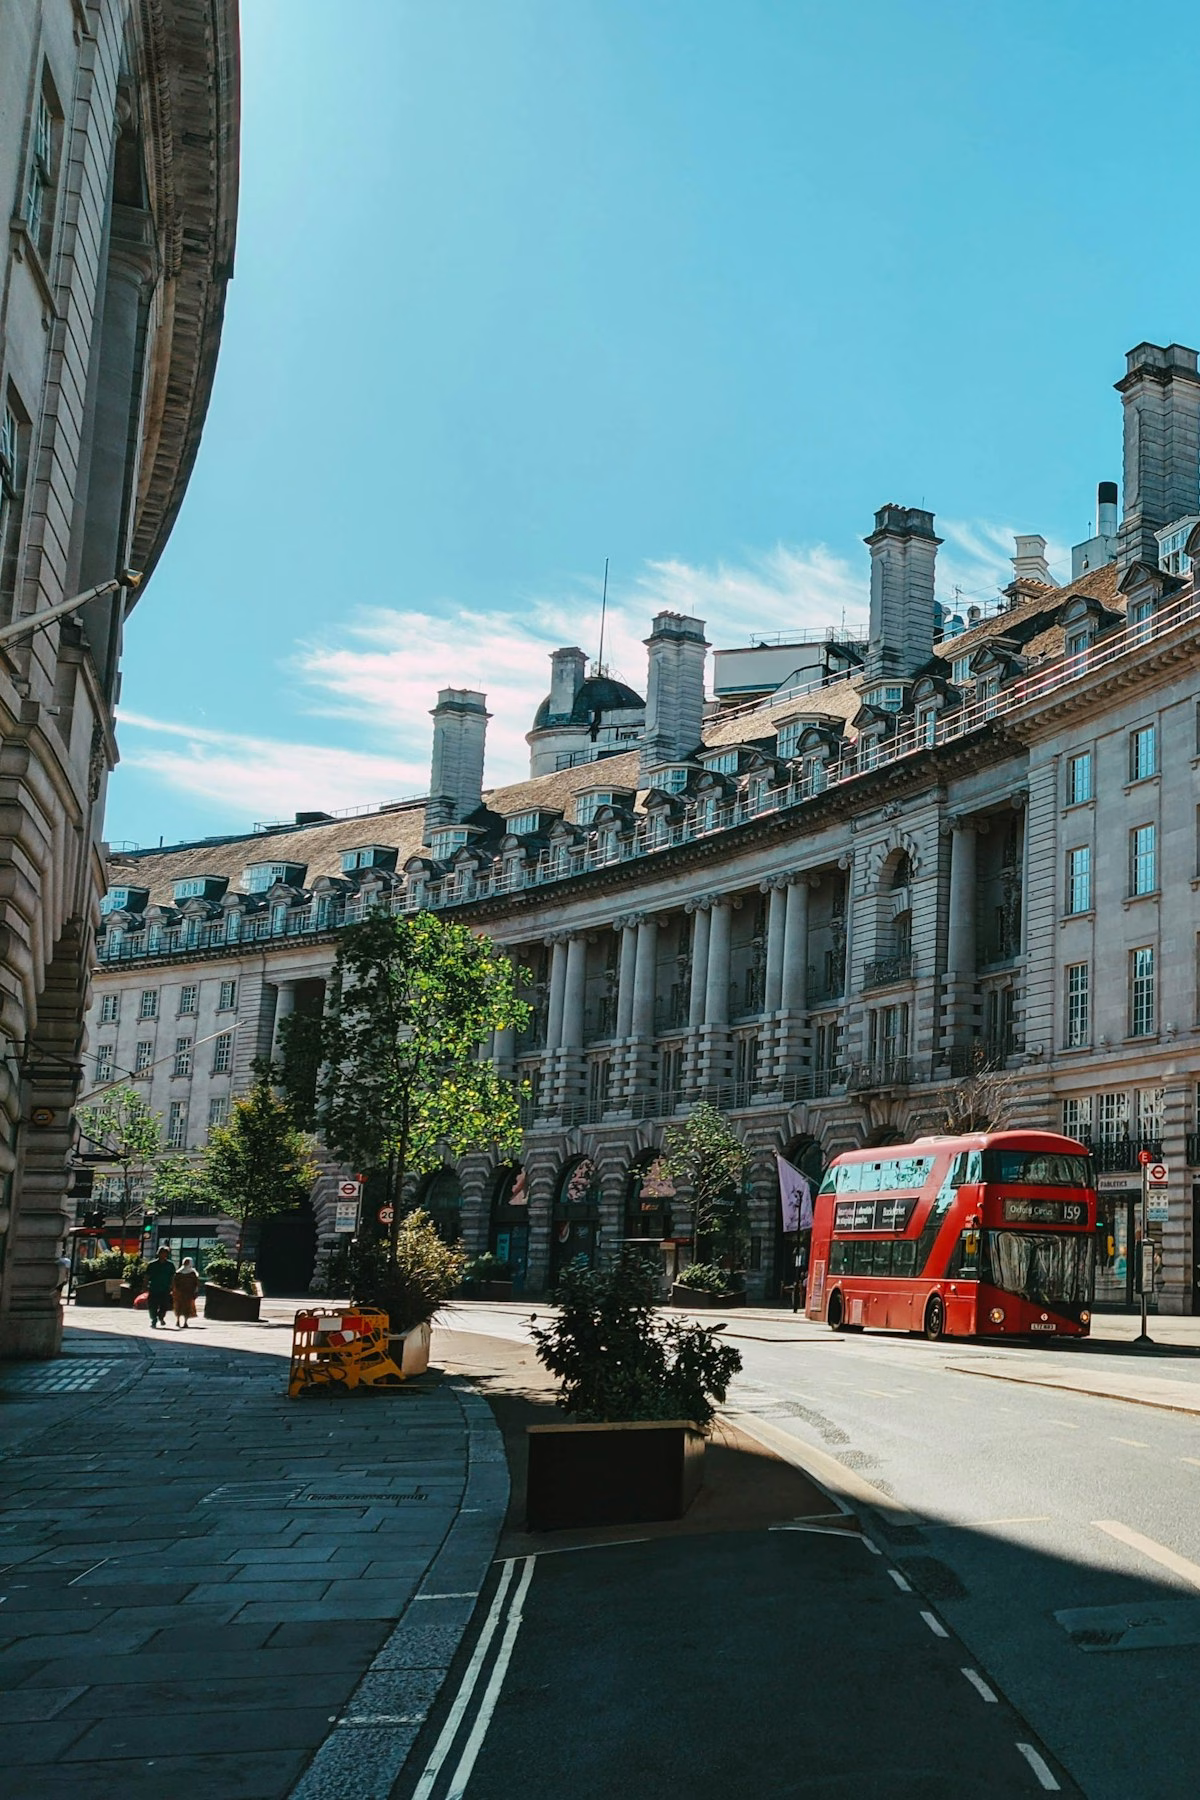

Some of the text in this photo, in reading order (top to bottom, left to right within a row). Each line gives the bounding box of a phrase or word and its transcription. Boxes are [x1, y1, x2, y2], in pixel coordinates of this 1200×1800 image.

[1141, 1152, 1149, 1162] E
[382, 1211, 394, 1219] 20
[1011, 1205, 1053, 1217] Oxford Circus
[1064, 1206, 1082, 1221] 159
